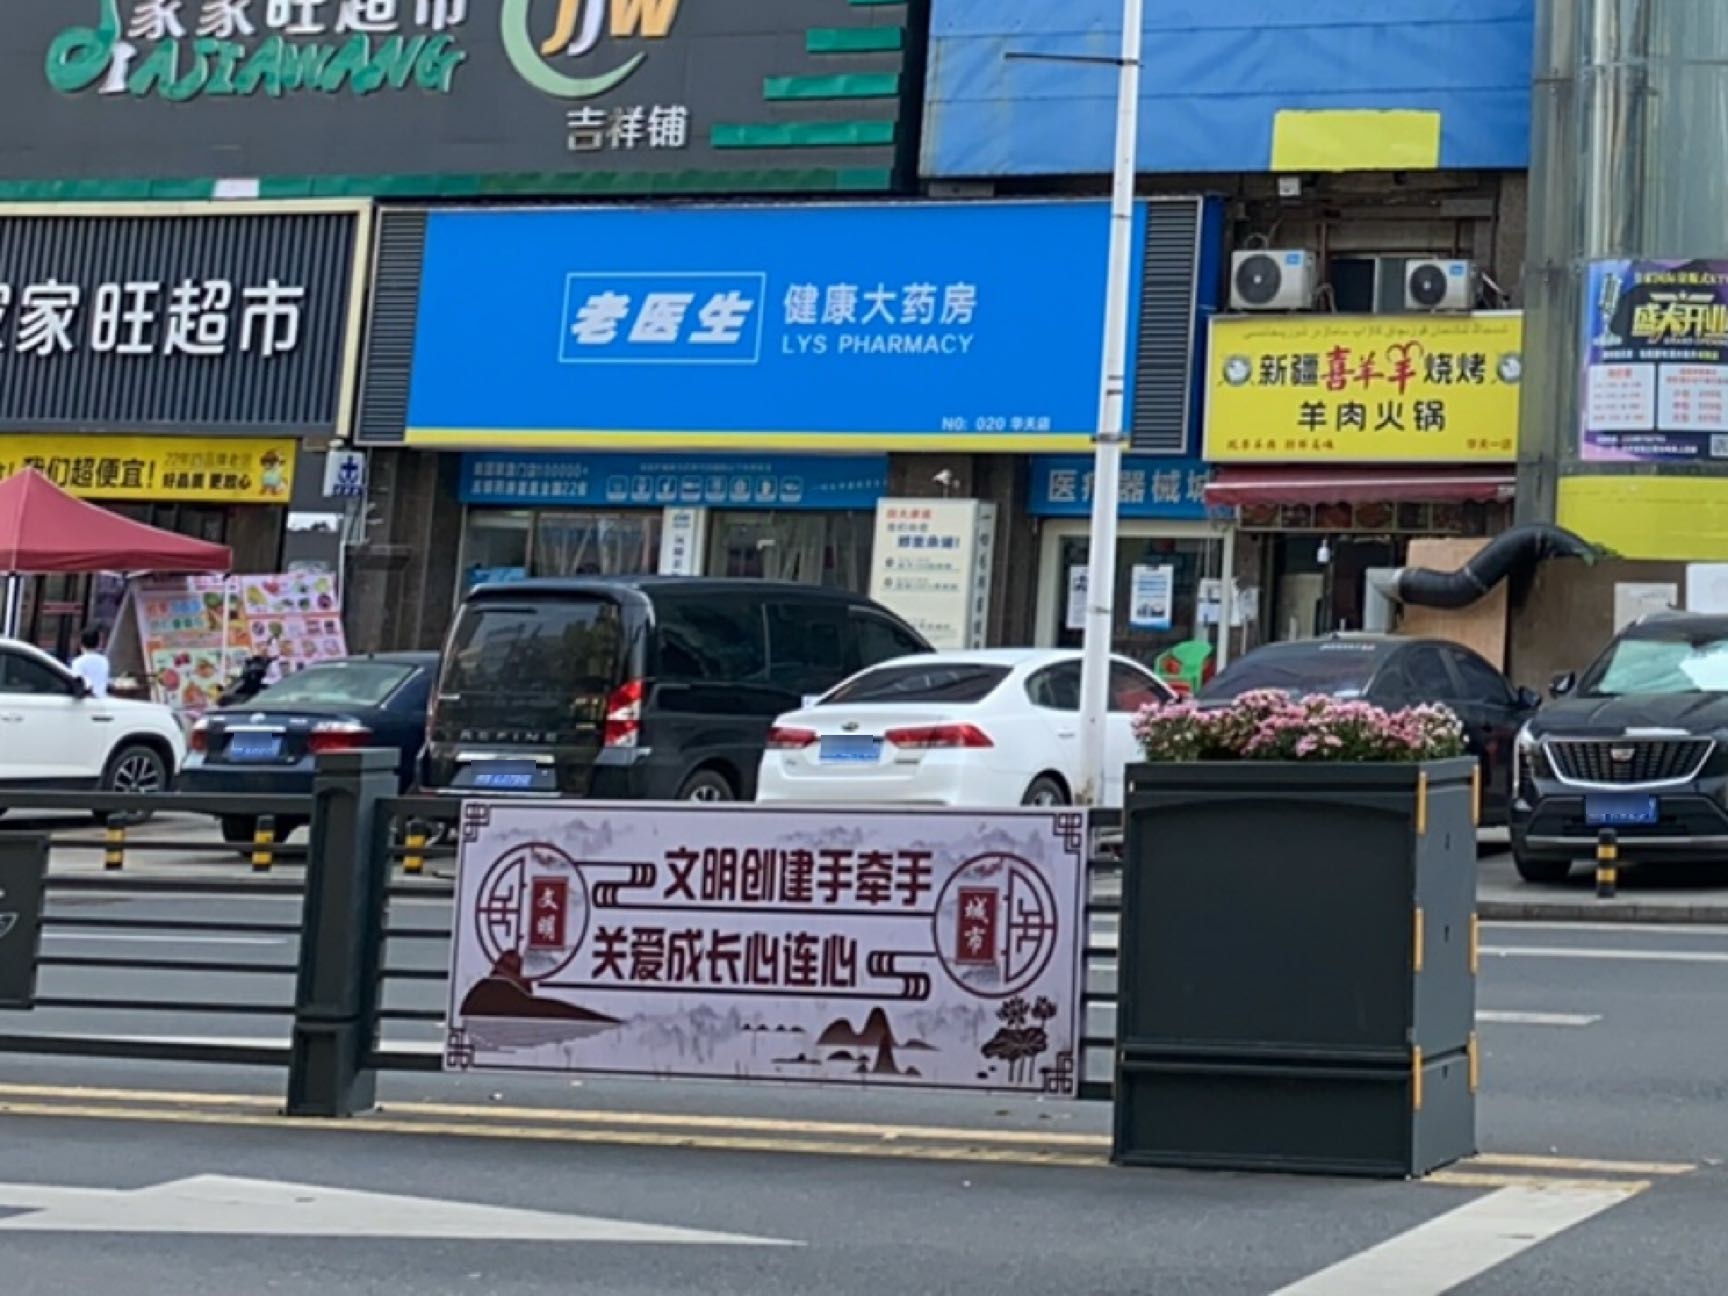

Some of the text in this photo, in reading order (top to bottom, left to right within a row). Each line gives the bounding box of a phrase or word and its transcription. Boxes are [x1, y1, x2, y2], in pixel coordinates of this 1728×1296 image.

[568, 105, 688, 152] 吉祥铺
[0, 278, 304, 356] 家旺超市
[571, 290, 754, 345] 老医生
[783, 282, 978, 326] 健康大药房
[782, 334, 975, 355] LYS PHARMACY
[1258, 340, 1487, 395] 新疆喜羊羊烧烤
[976, 417, 1005, 432] 020
[1297, 400, 1446, 432] 羊肉火锅
[663, 846, 933, 908] 文明创建手牵手
[537, 885, 560, 942] 文明
[963, 899, 989, 954] 城市
[591, 925, 858, 989] 关爱成长心连心
